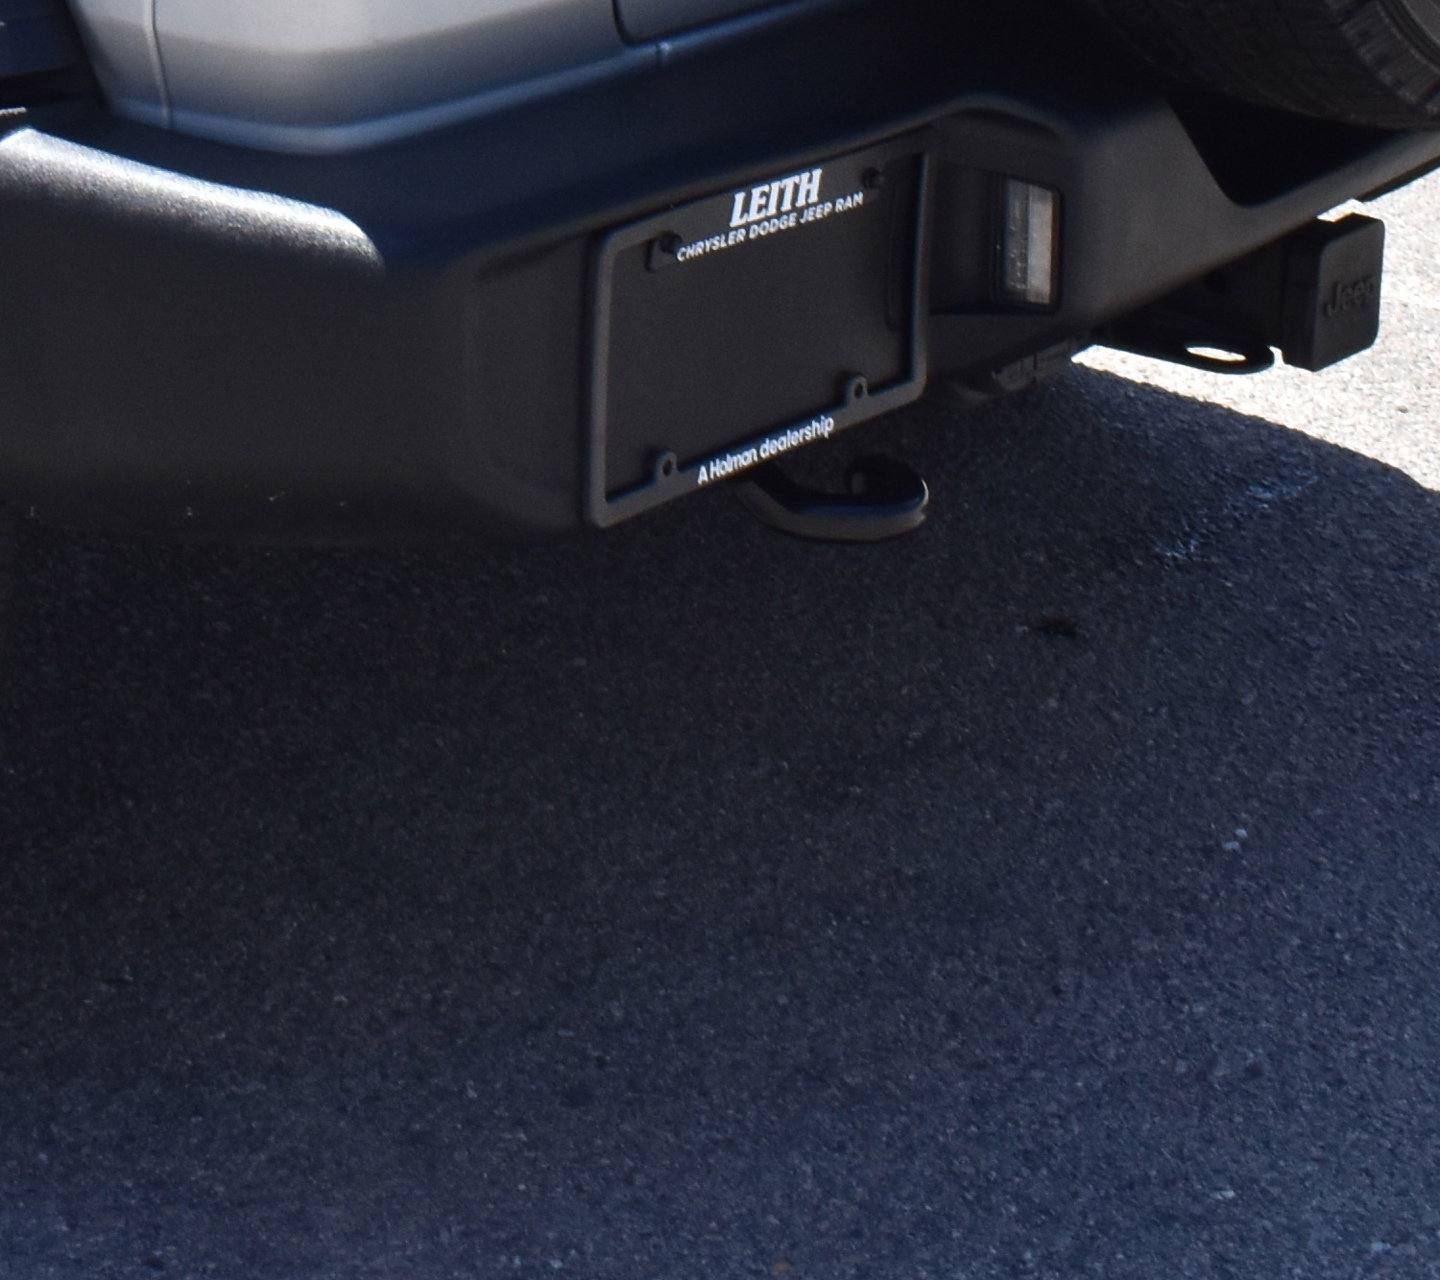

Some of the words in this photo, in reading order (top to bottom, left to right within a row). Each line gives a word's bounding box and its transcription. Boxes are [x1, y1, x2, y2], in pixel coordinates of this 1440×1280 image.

[729, 168, 823, 228] LEITH
[676, 227, 747, 263] CHRYSLER
[748, 211, 798, 240] DODGE
[799, 201, 833, 224] JEEP
[1322, 274, 1377, 318] Jeep
[697, 465, 709, 486] A
[709, 447, 759, 479] Holman
[759, 415, 835, 459] dealership
